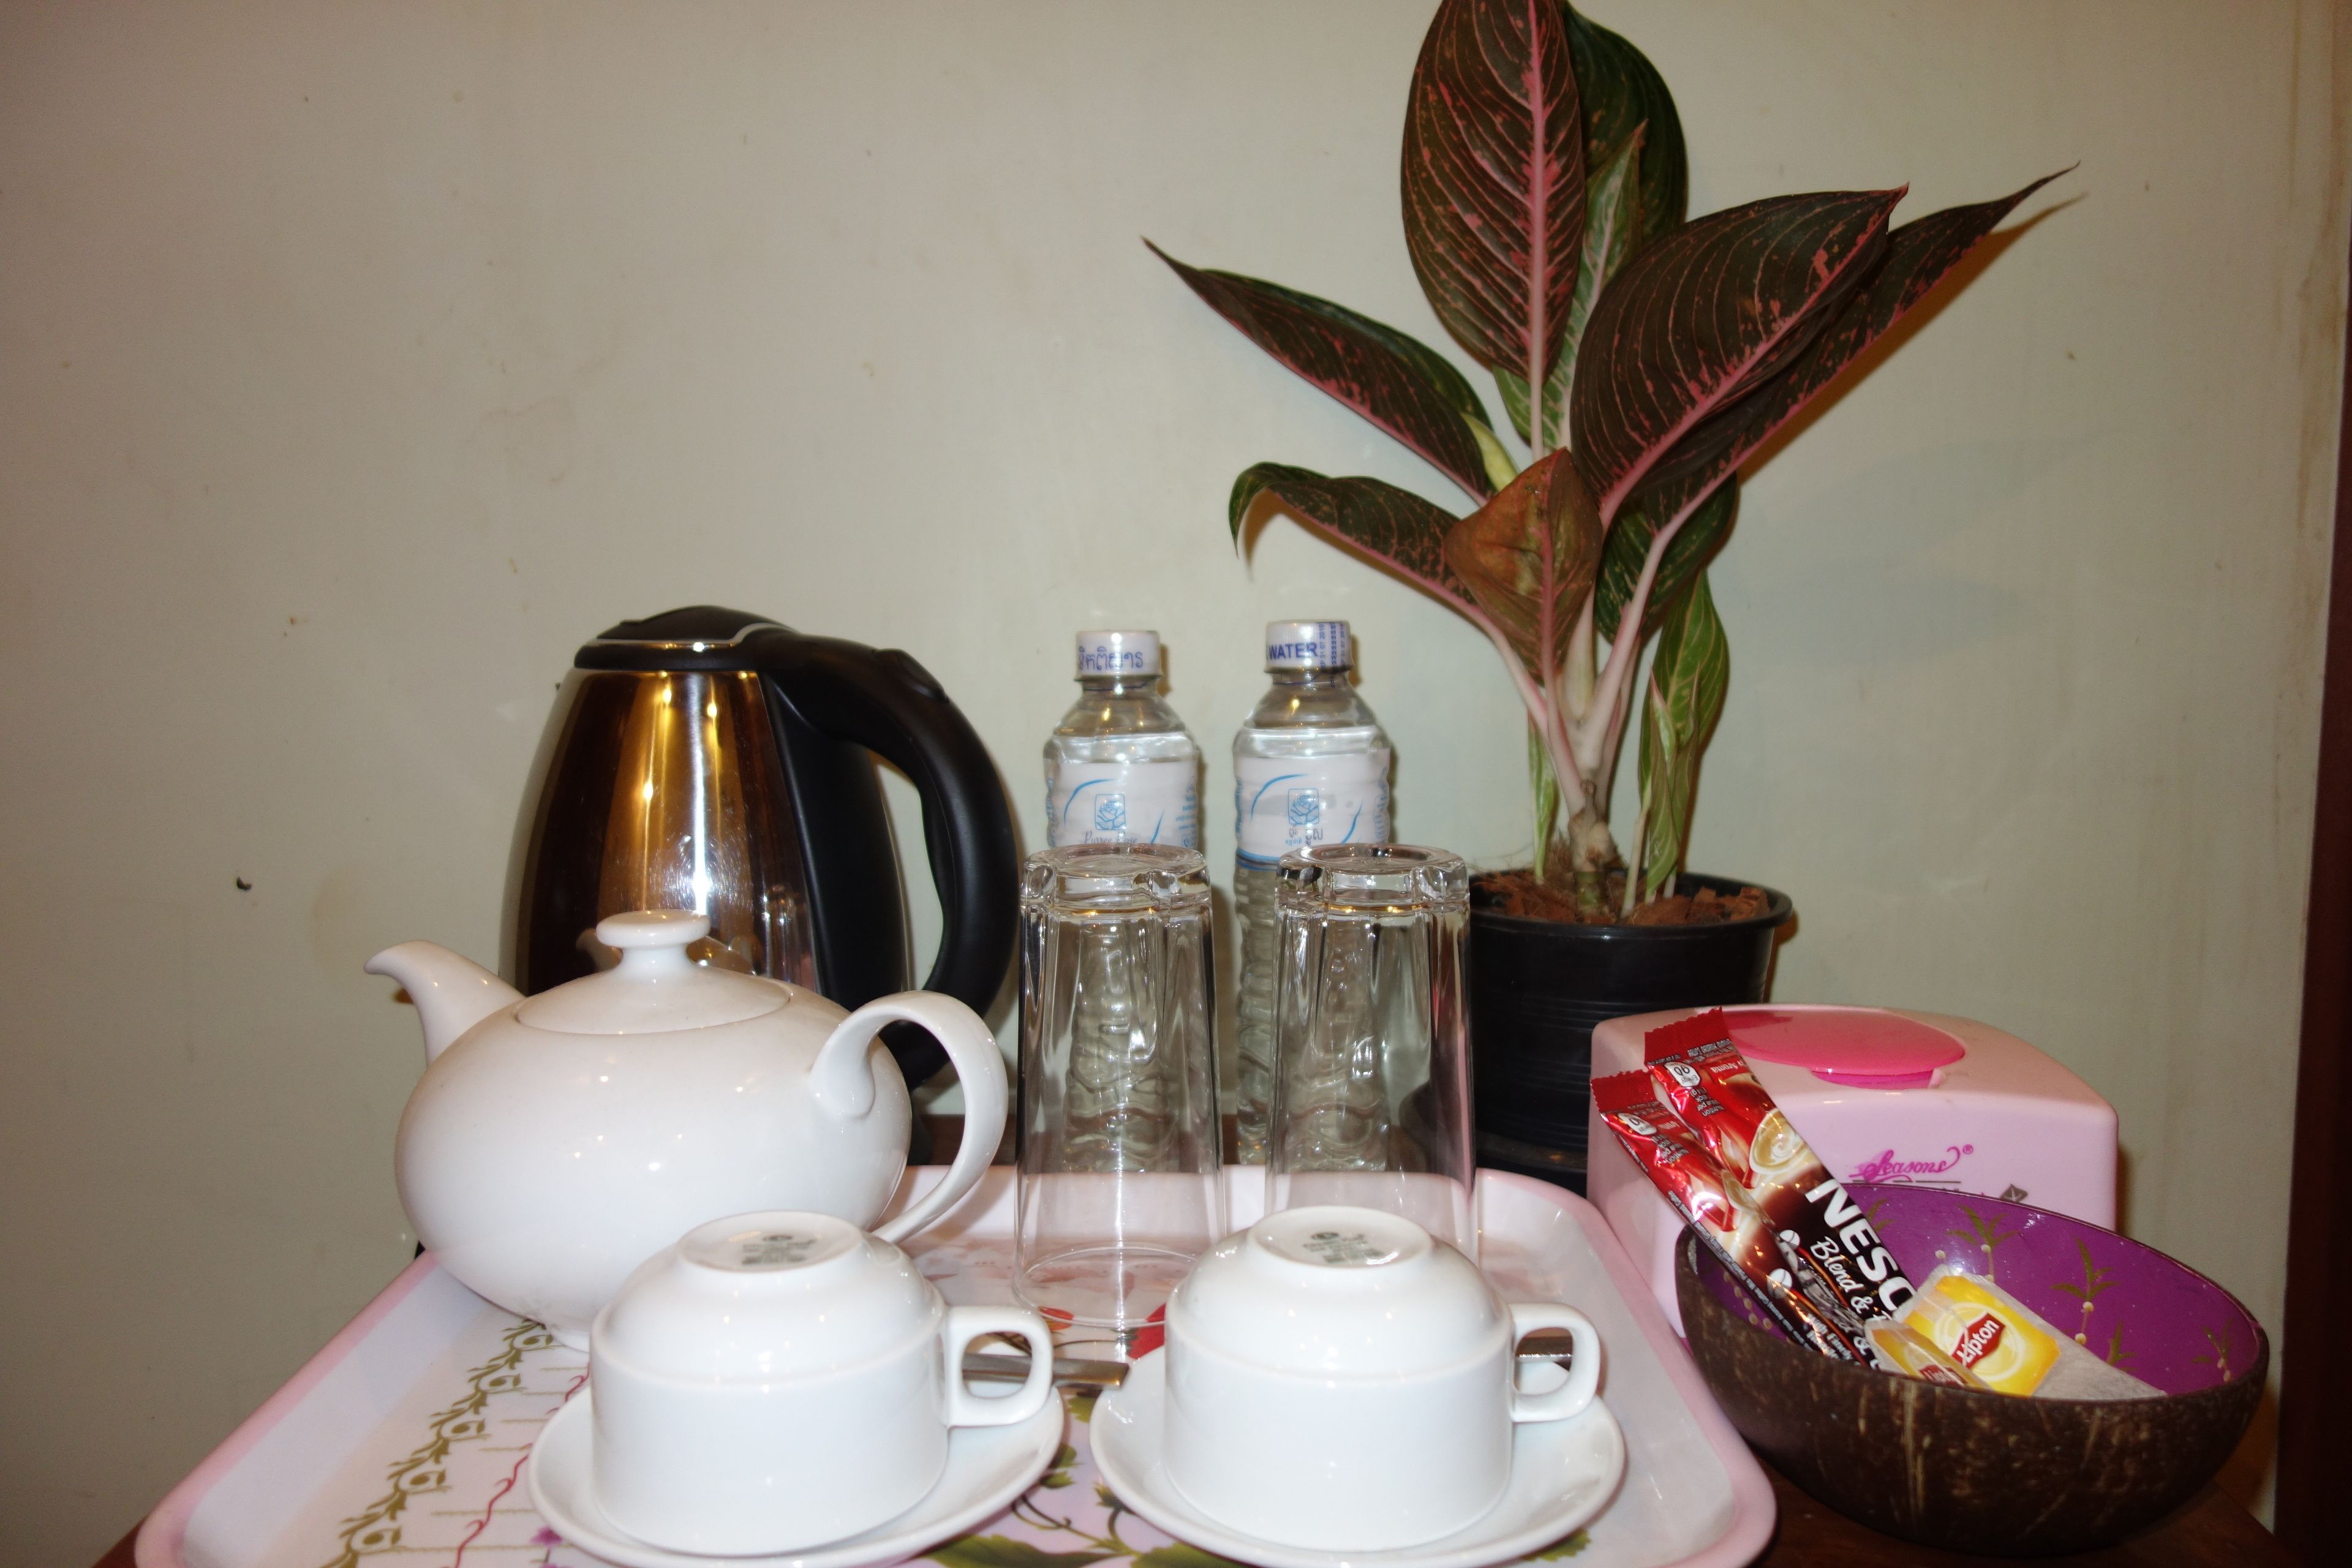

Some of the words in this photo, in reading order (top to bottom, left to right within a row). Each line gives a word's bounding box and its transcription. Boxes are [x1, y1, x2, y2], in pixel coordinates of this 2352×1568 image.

[1269, 641, 1318, 660] WATER
[1673, 1066, 1691, 1076] 90
[1805, 1178, 1917, 1311] NESC
[1810, 1235, 1864, 1293] Blend
[1850, 1296, 1874, 1314] &
[1956, 1320, 2000, 1363] Lipton
